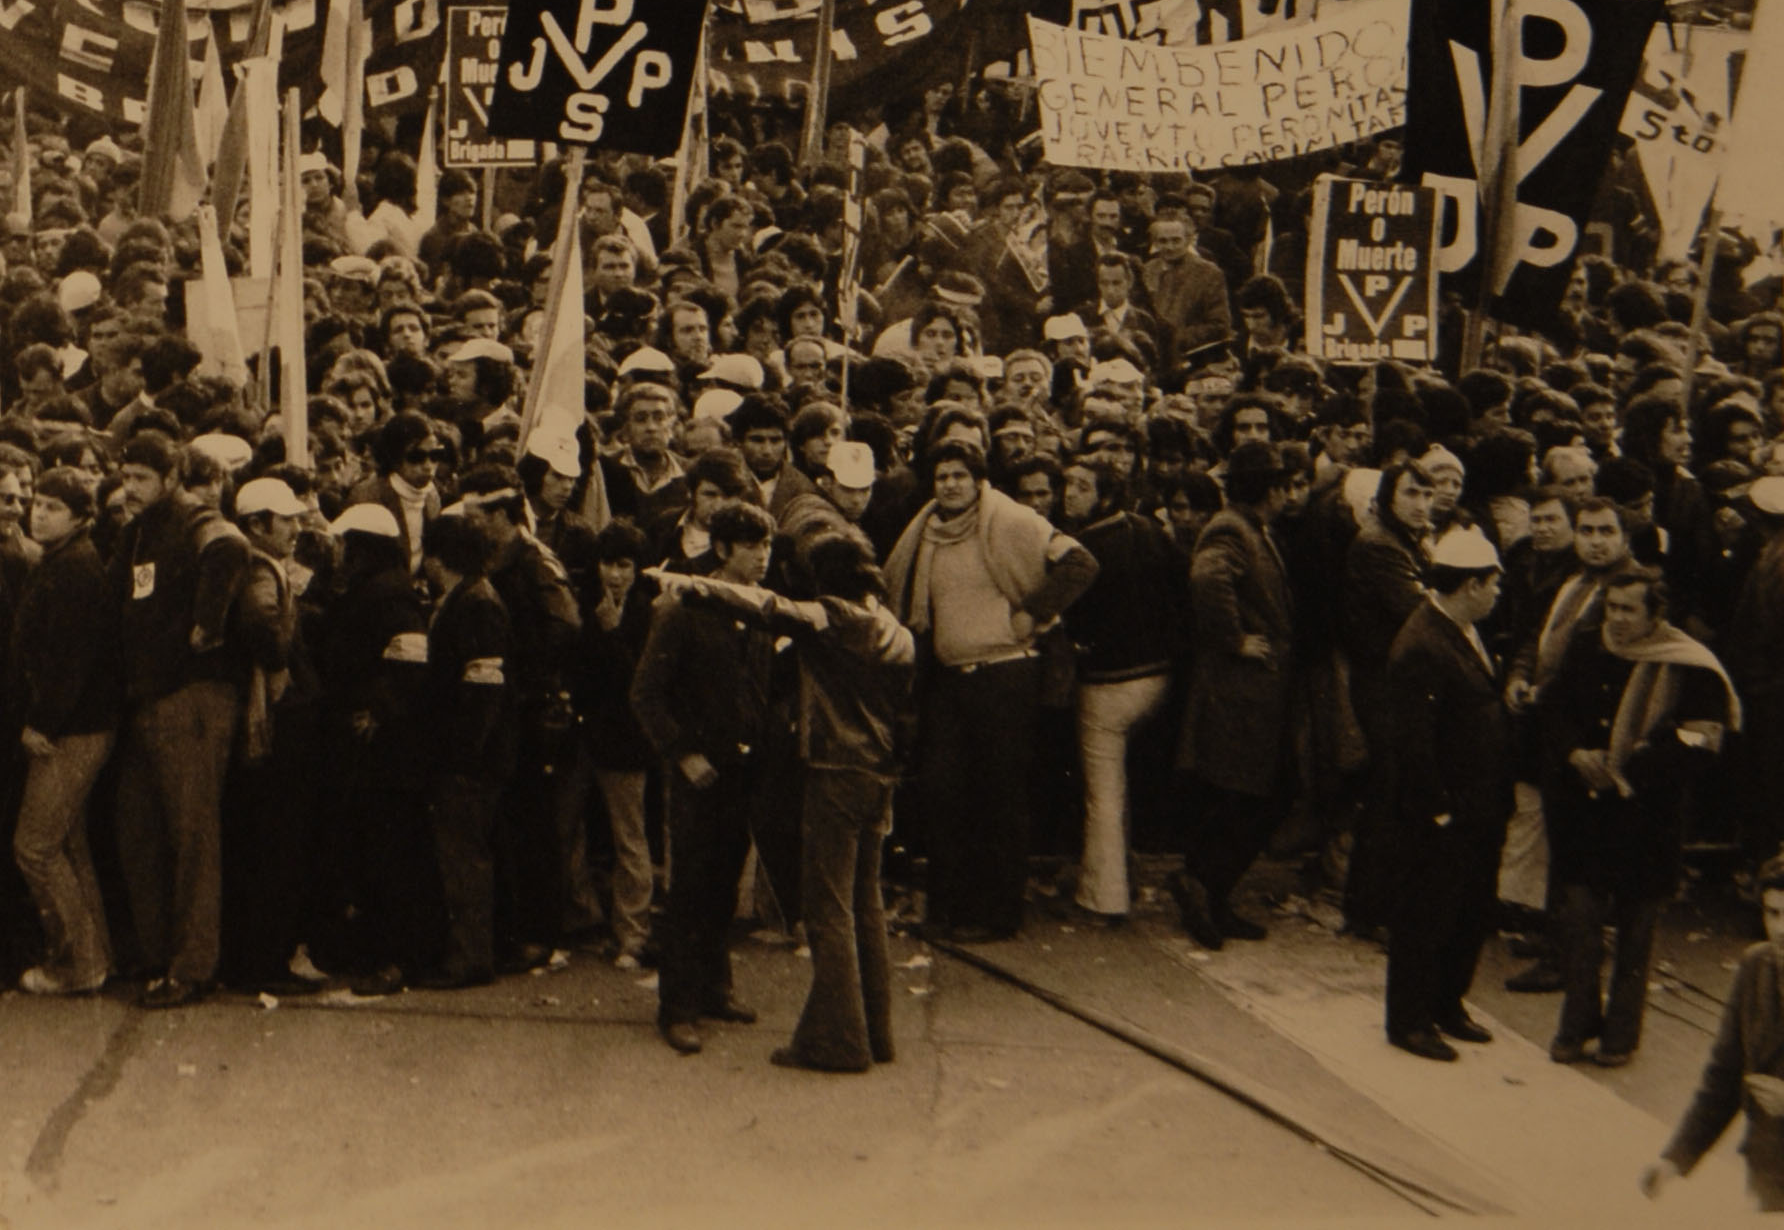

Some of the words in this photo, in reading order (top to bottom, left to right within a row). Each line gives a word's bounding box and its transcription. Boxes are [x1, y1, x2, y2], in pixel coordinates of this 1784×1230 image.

[468, 10, 507, 38] Per
[1038, 76, 1239, 120] GENERAL
[1348, 182, 1415, 216] Perón
[1336, 237, 1417, 272] Muerte
[1324, 337, 1391, 363] Brigada
